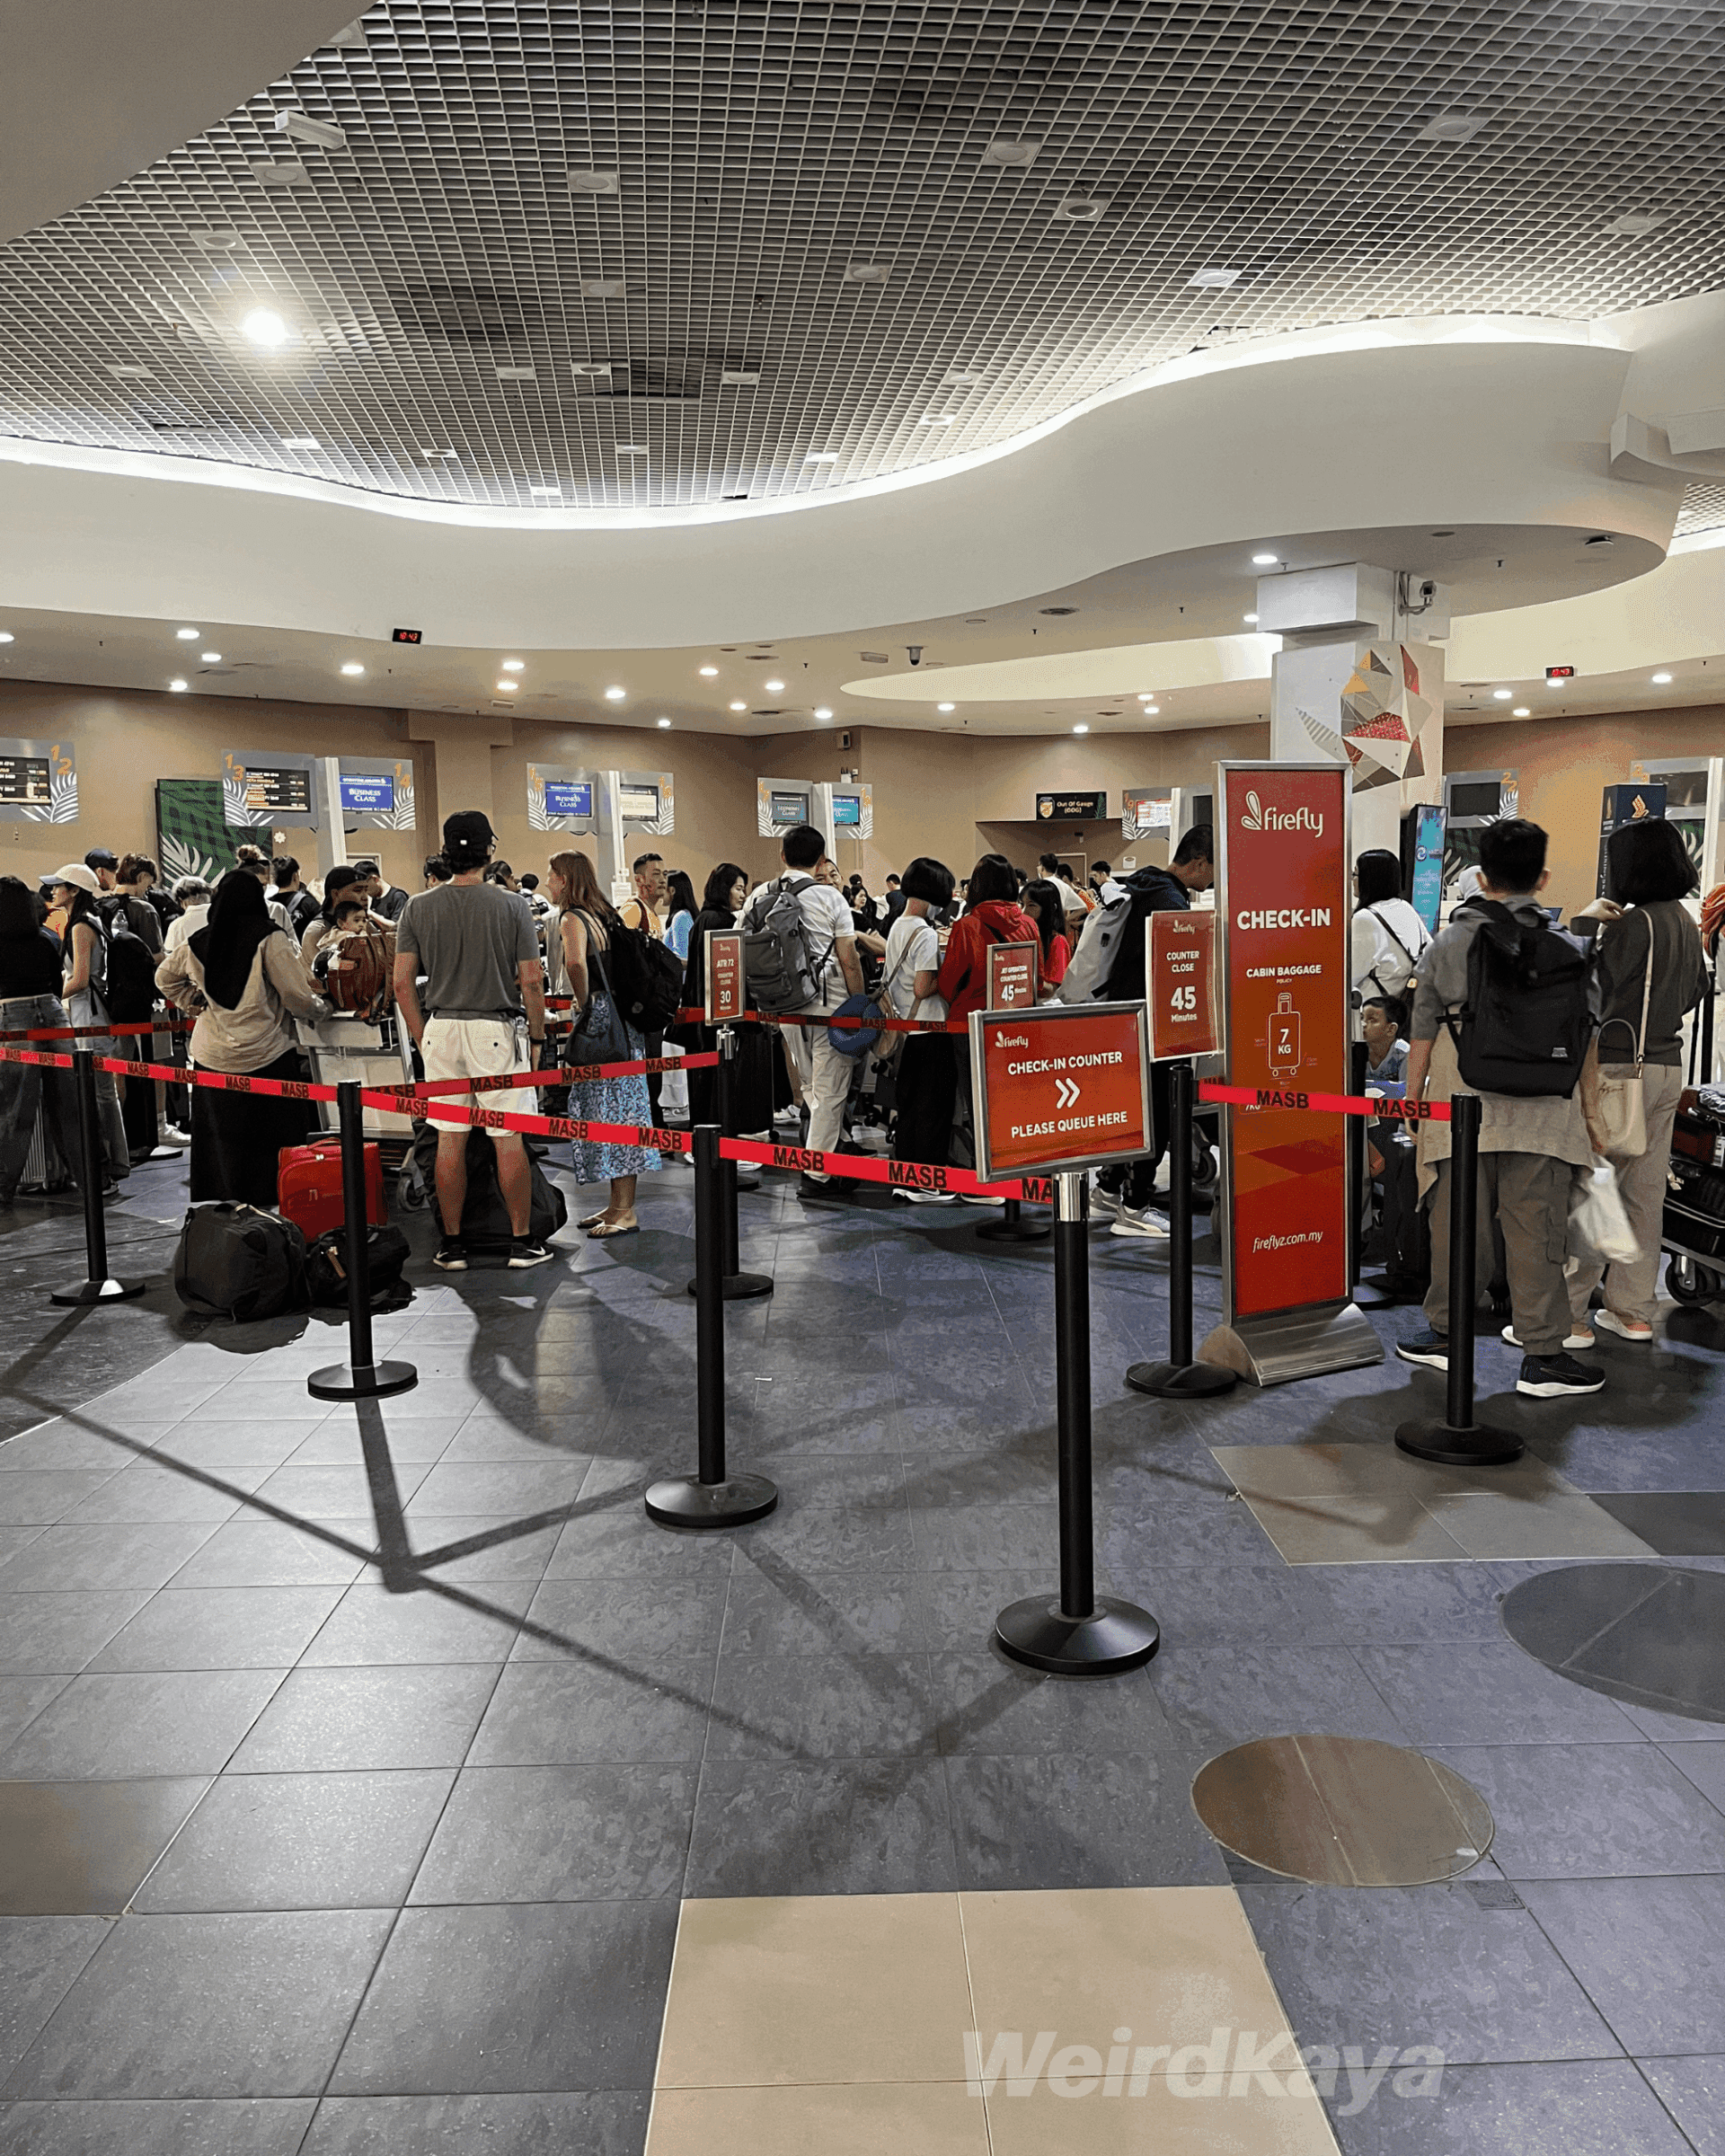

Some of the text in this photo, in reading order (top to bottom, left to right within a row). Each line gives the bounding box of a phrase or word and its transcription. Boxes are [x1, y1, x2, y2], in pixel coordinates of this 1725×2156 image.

[349, 788, 381, 796] BUSINESS
[1264, 807, 1323, 838] firefly
[1237, 908, 1331, 930] CHECK-IN
[717, 959, 734, 968] ATR 72
[1166, 950, 1199, 961] COUNTER
[1172, 963, 1195, 973] CLOSE
[1246, 964, 1322, 978] CABIN BAGGAGE
[720, 990, 731, 1003] 30
[1001, 985, 1014, 1002] 45
[1171, 985, 1197, 1011] 45
[1172, 1013, 1198, 1022] Minutes
[1004, 1036, 1029, 1048] firefly
[1280, 1029, 1289, 1043] 7
[1278, 1044, 1291, 1055] KG
[1008, 1051, 1123, 1075] CHECK-IN COUNTER
[469, 1074, 513, 1092] MASB
[562, 1065, 601, 1082] MASB
[645, 1057, 682, 1073] MASB
[226, 1076, 252, 1091] MASB
[281, 1082, 309, 1099] MASB
[1257, 1090, 1431, 1118] MASB MASB
[395, 1098, 682, 1150] MASB MASB MASB MASB
[1011, 1111, 1128, 1138] PLEASE QUEUE HERE
[774, 1146, 1053, 1202] MASB MASB MA
[1252, 1232, 1323, 1253] fireflyz.com.my
